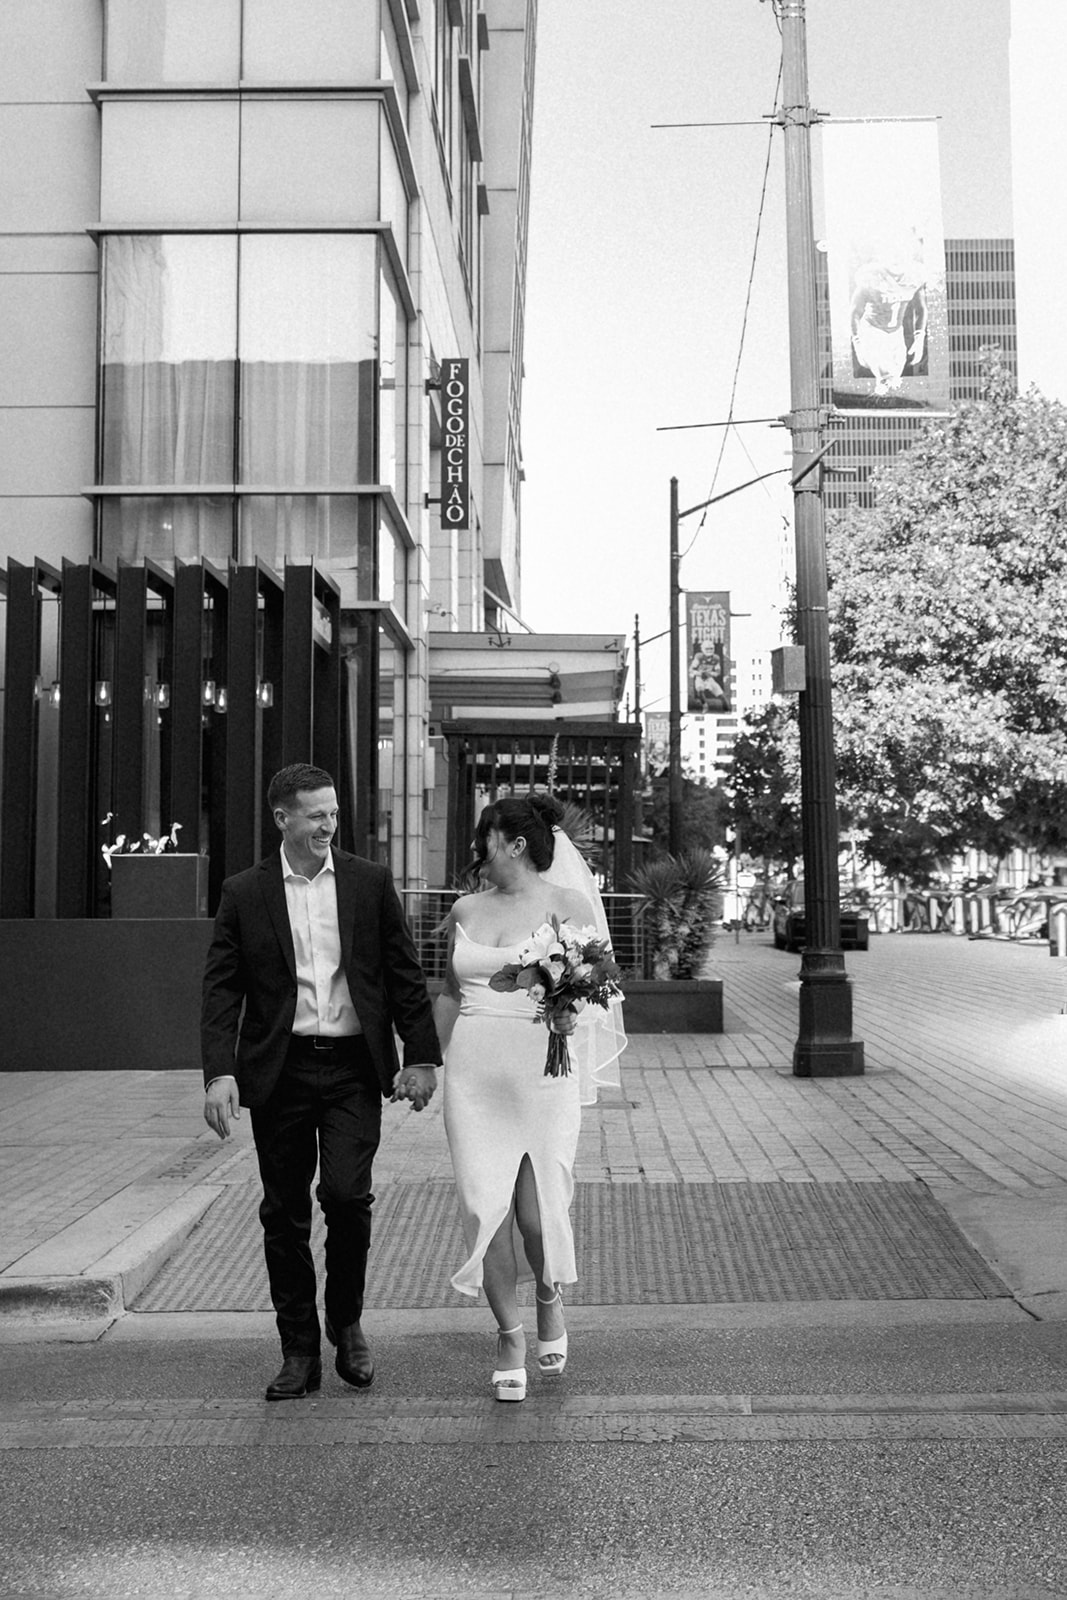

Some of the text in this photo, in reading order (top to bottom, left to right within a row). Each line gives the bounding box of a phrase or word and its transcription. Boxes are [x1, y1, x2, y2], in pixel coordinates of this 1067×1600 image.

[445, 363, 466, 523] FOGO DE CHÃO
[690, 609, 726, 626] TEXAS
[691, 626, 726, 644] FIGHT
